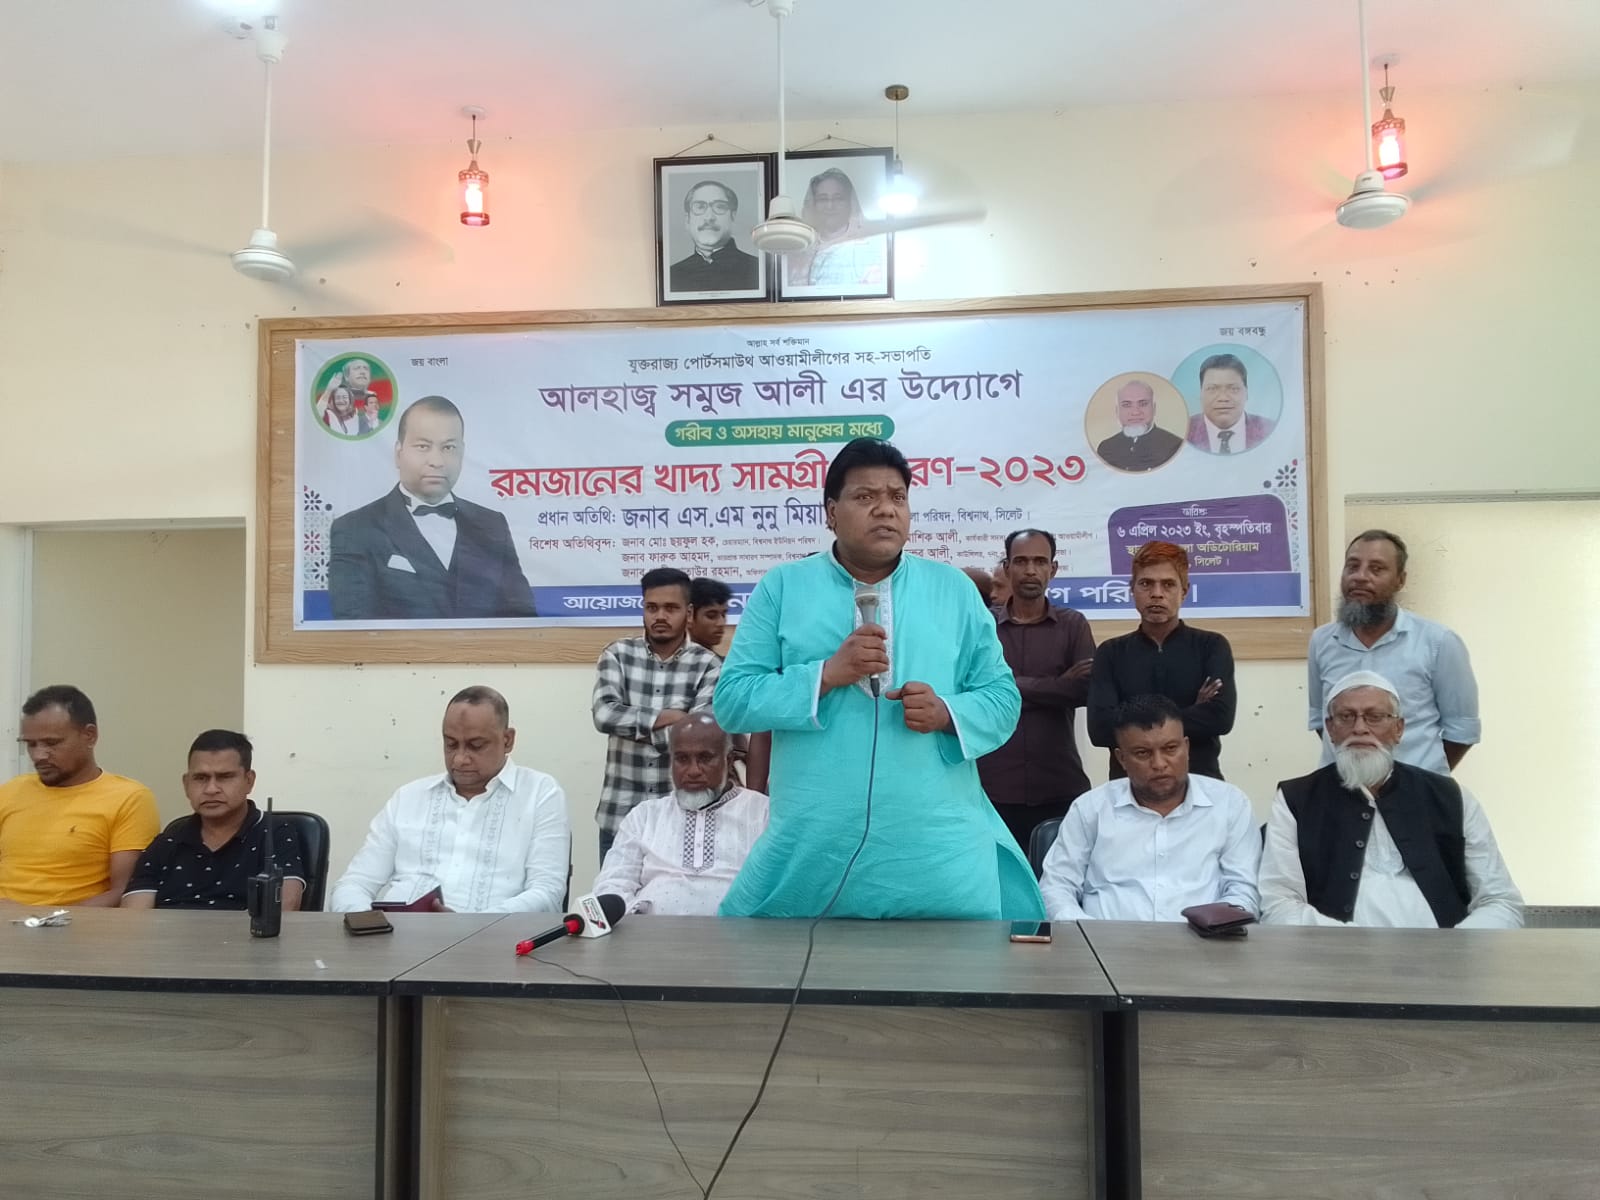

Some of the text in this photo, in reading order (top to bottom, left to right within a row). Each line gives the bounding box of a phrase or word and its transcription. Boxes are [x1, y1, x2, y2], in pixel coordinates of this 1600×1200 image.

[1220, 326, 1266, 338] জয় বঙ্গবন্ধু
[411, 357, 449, 367] জয় বাংলা
[628, 346, 932, 375] যুক্তরাজ্য পোর্টসমাউথ আওয়ামীলীগের সহ-সভাপতি
[538, 368, 1023, 417] আলহাজ্ব সমুজ আলী এর উদ্যোগে
[675, 419, 884, 442] গরীব ও অসহায় মানুষের মধ্যে
[489, 465, 644, 499] রমজানের
[654, 462, 722, 496] খাদ্য
[731, 447, 829, 492] সামগ্রী
[537, 496, 824, 532] প্রধান অতিথি: জনাব এস.এম নুনু মিয়া
[923, 508, 954, 523] পরিষদ,
[958, 508, 992, 523] বিশ্বনাথ,
[996, 507, 1022, 522] সিলেট
[936, 529, 962, 544] আলী,
[1117, 520, 1272, 541] ৬ এপ্রিল ২০২৩ ইং, বৃহস্পতিবার
[529, 536, 616, 554] বিশেষ অতিথিবৃন্দ:
[622, 537, 645, 548] জনাব
[648, 536, 667, 548] মোঃ
[701, 536, 719, 549] হক,
[1197, 540, 1260, 554] অডিটোরিয়াম
[622, 552, 645, 563] জনাব
[648, 552, 676, 563] ফারুক
[927, 545, 953, 560] আলী,
[1195, 556, 1223, 568] সিলেট
[622, 567, 645, 579] জনাব
